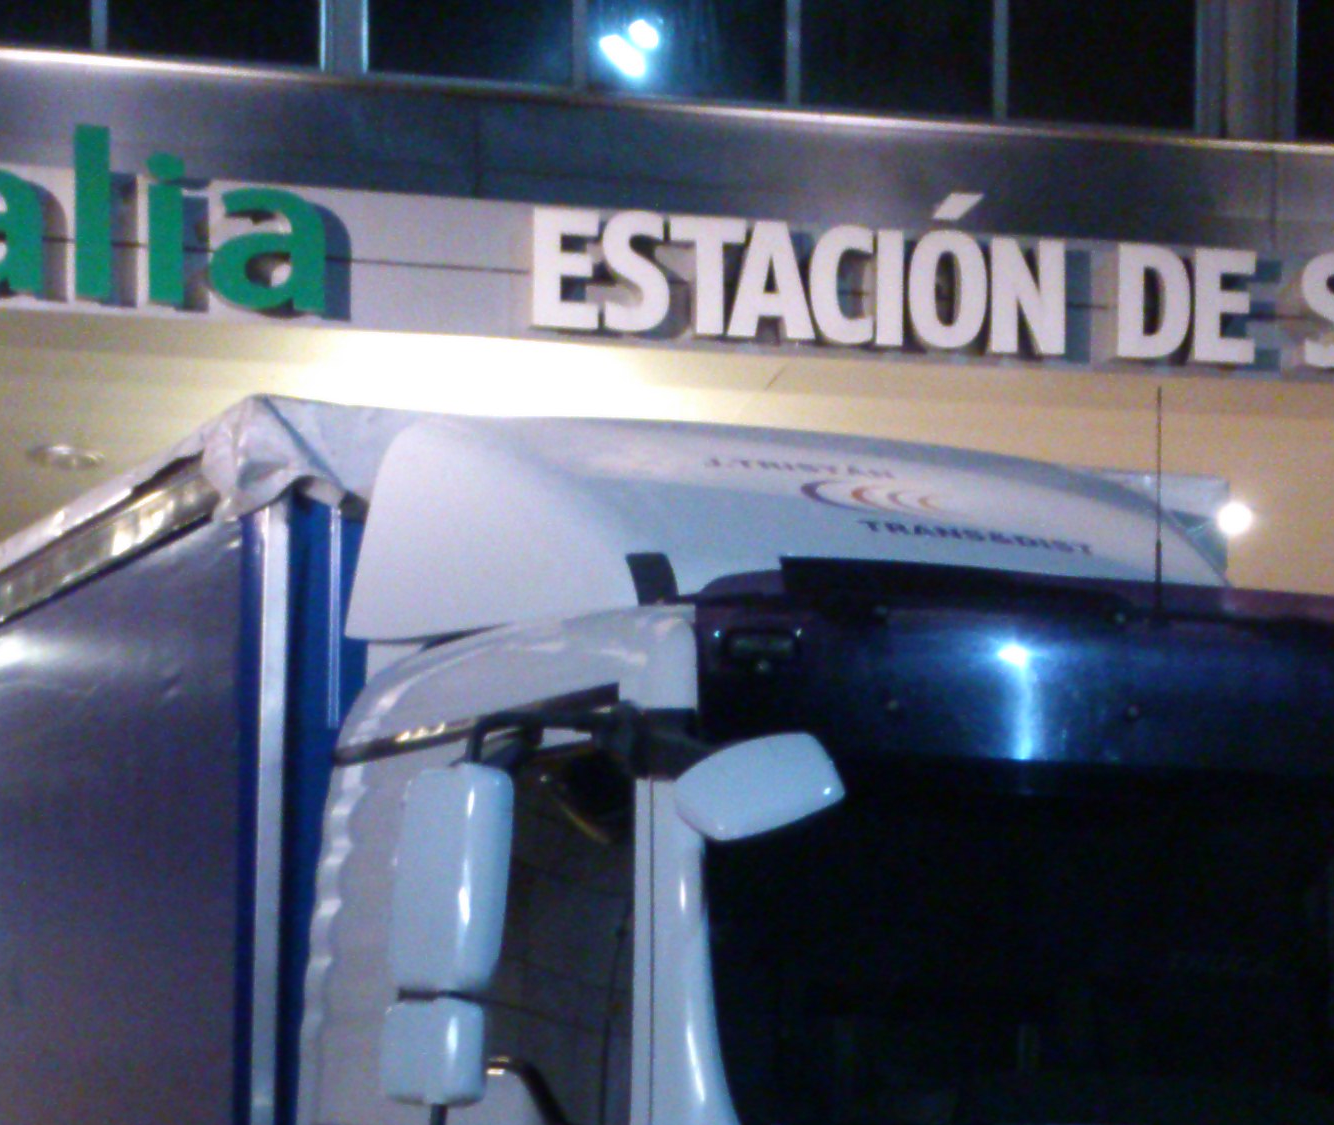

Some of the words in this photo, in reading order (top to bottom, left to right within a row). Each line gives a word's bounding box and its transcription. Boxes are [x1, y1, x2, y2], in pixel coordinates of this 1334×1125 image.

[531, 192, 1067, 356] ESTACIÓN
[1116, 242, 1257, 365] DE
[856, 518, 1095, 556] TRANS&DIST
